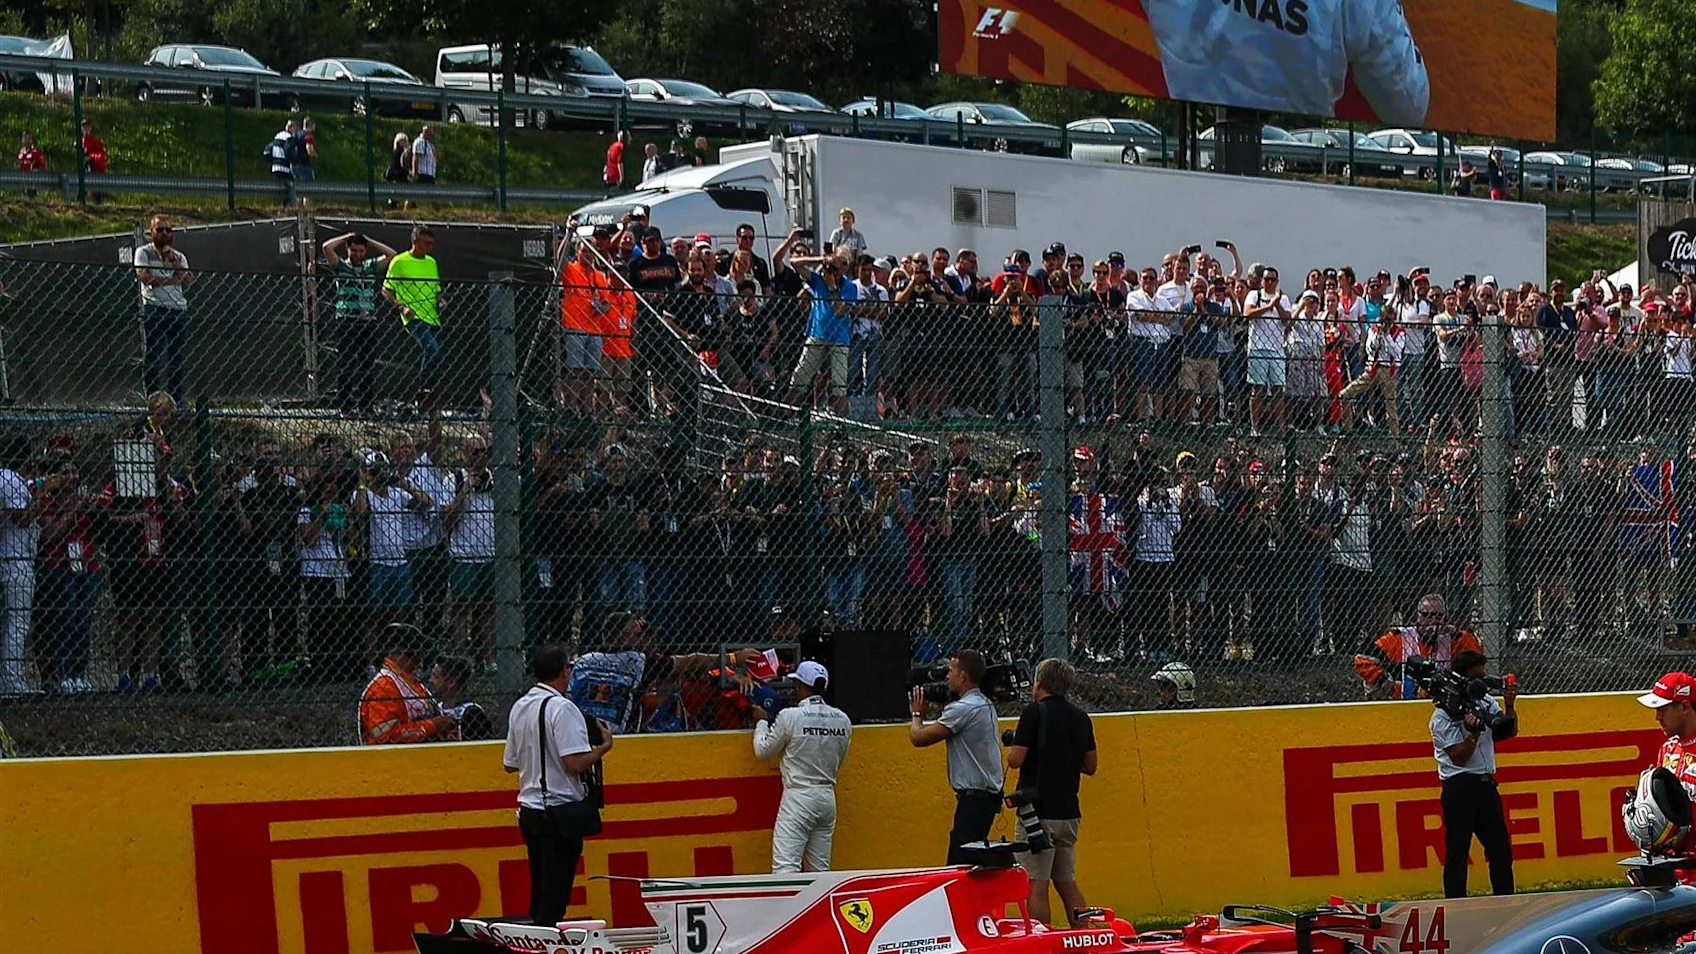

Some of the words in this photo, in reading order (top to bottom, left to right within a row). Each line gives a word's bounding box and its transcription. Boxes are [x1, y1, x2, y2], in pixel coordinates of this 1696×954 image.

[803, 728, 845, 737] PETRONAS
[686, 906, 708, 954] 5
[878, 938, 935, 950] SCUDERIA
[1063, 934, 1114, 948] HUBLOT
[902, 943, 952, 954] FERRARI
